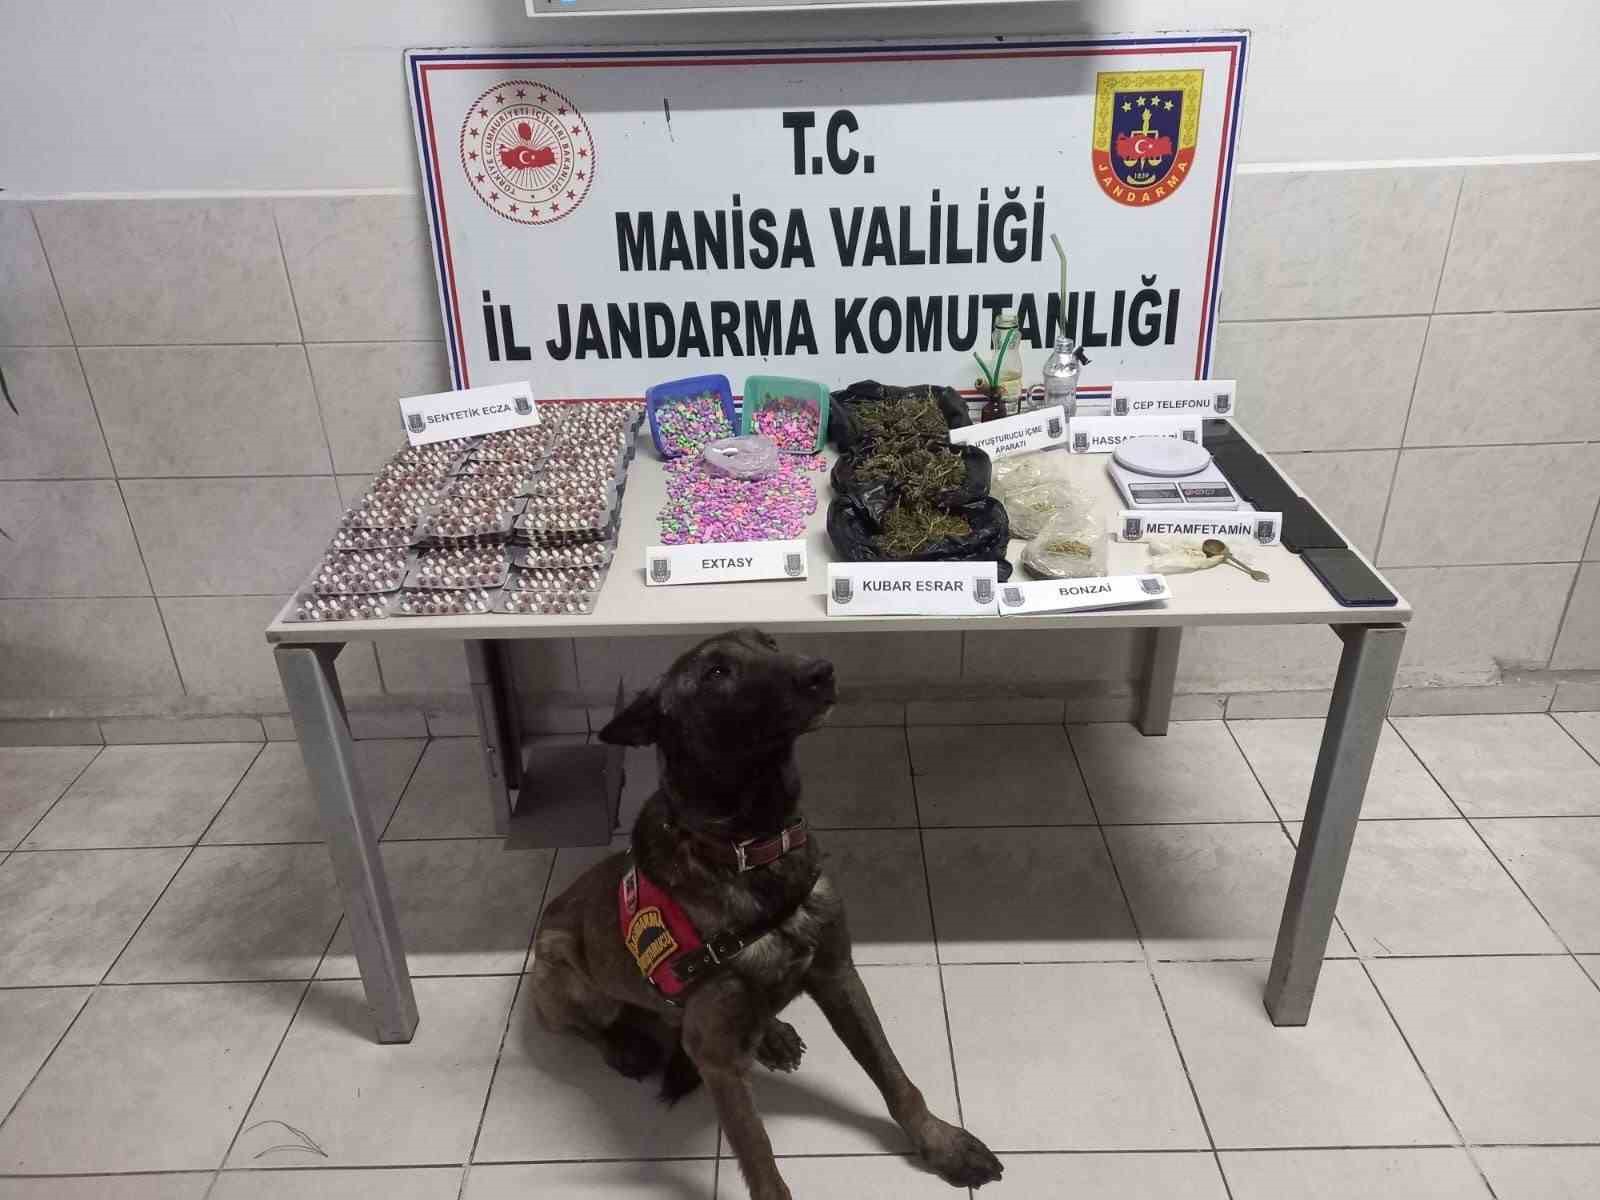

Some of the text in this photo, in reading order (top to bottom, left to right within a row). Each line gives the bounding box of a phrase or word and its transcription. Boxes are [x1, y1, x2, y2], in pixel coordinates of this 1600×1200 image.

[783, 109, 875, 175] T.C.
[1098, 160, 1188, 203] JANDARMA
[615, 185, 1044, 271] MANİSA VALİLİĞİ
[482, 274, 1181, 361] İL JANDARMA KOMUTANLIĞI
[426, 403, 512, 424] SENTETİK ECZA
[1133, 399, 1210, 410] CEP TELEFONU
[1146, 522, 1252, 536] METAMFETAMİN
[702, 558, 753, 569] EXTASY
[863, 580, 964, 592] KUBAR ESRAR
